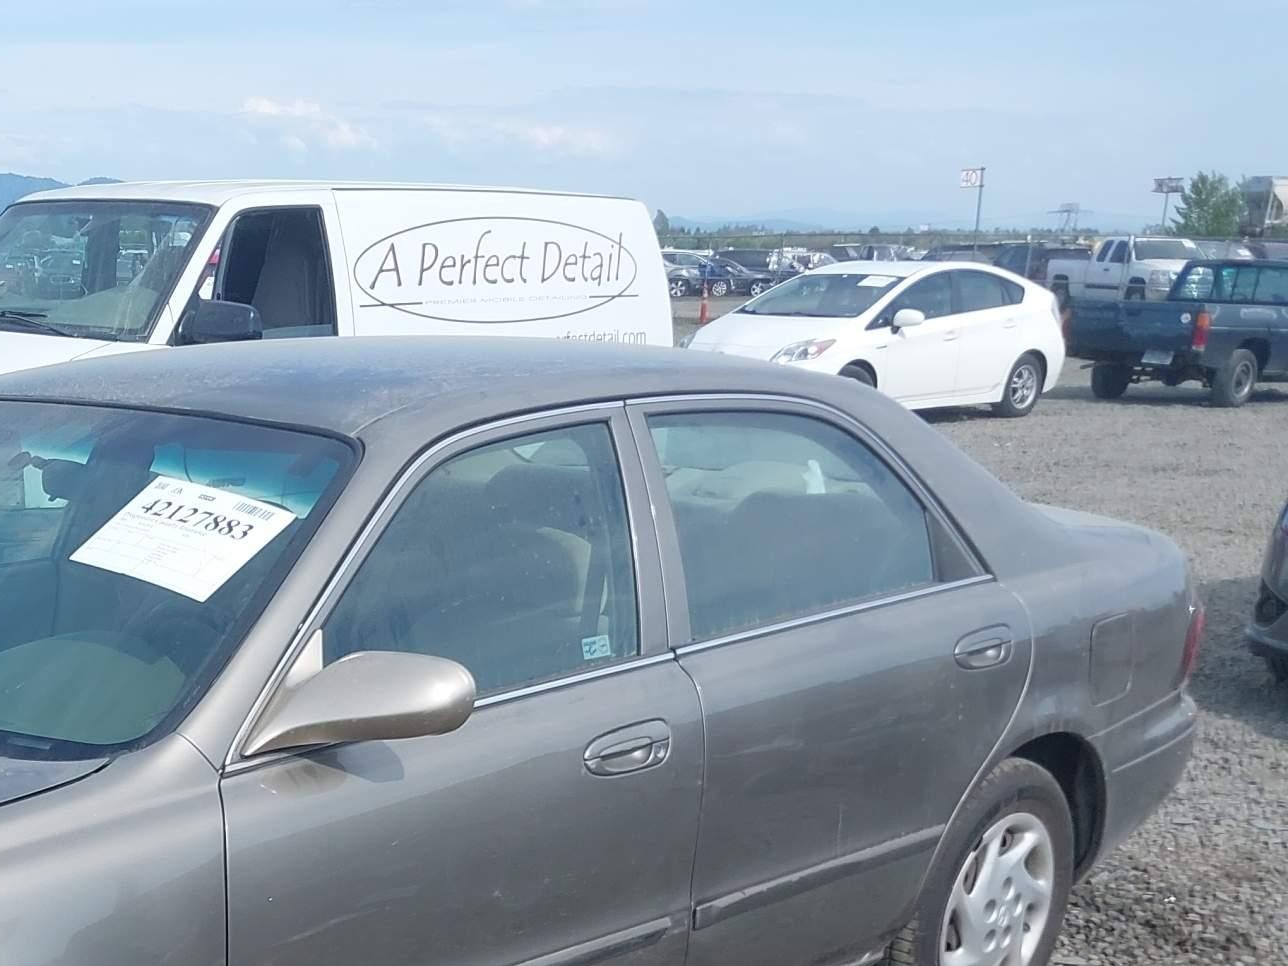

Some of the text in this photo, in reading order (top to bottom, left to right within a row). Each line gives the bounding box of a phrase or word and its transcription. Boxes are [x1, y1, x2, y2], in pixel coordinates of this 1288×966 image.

[369, 230, 622, 290] A Perfect Detail
[142, 499, 254, 539] 42127883
